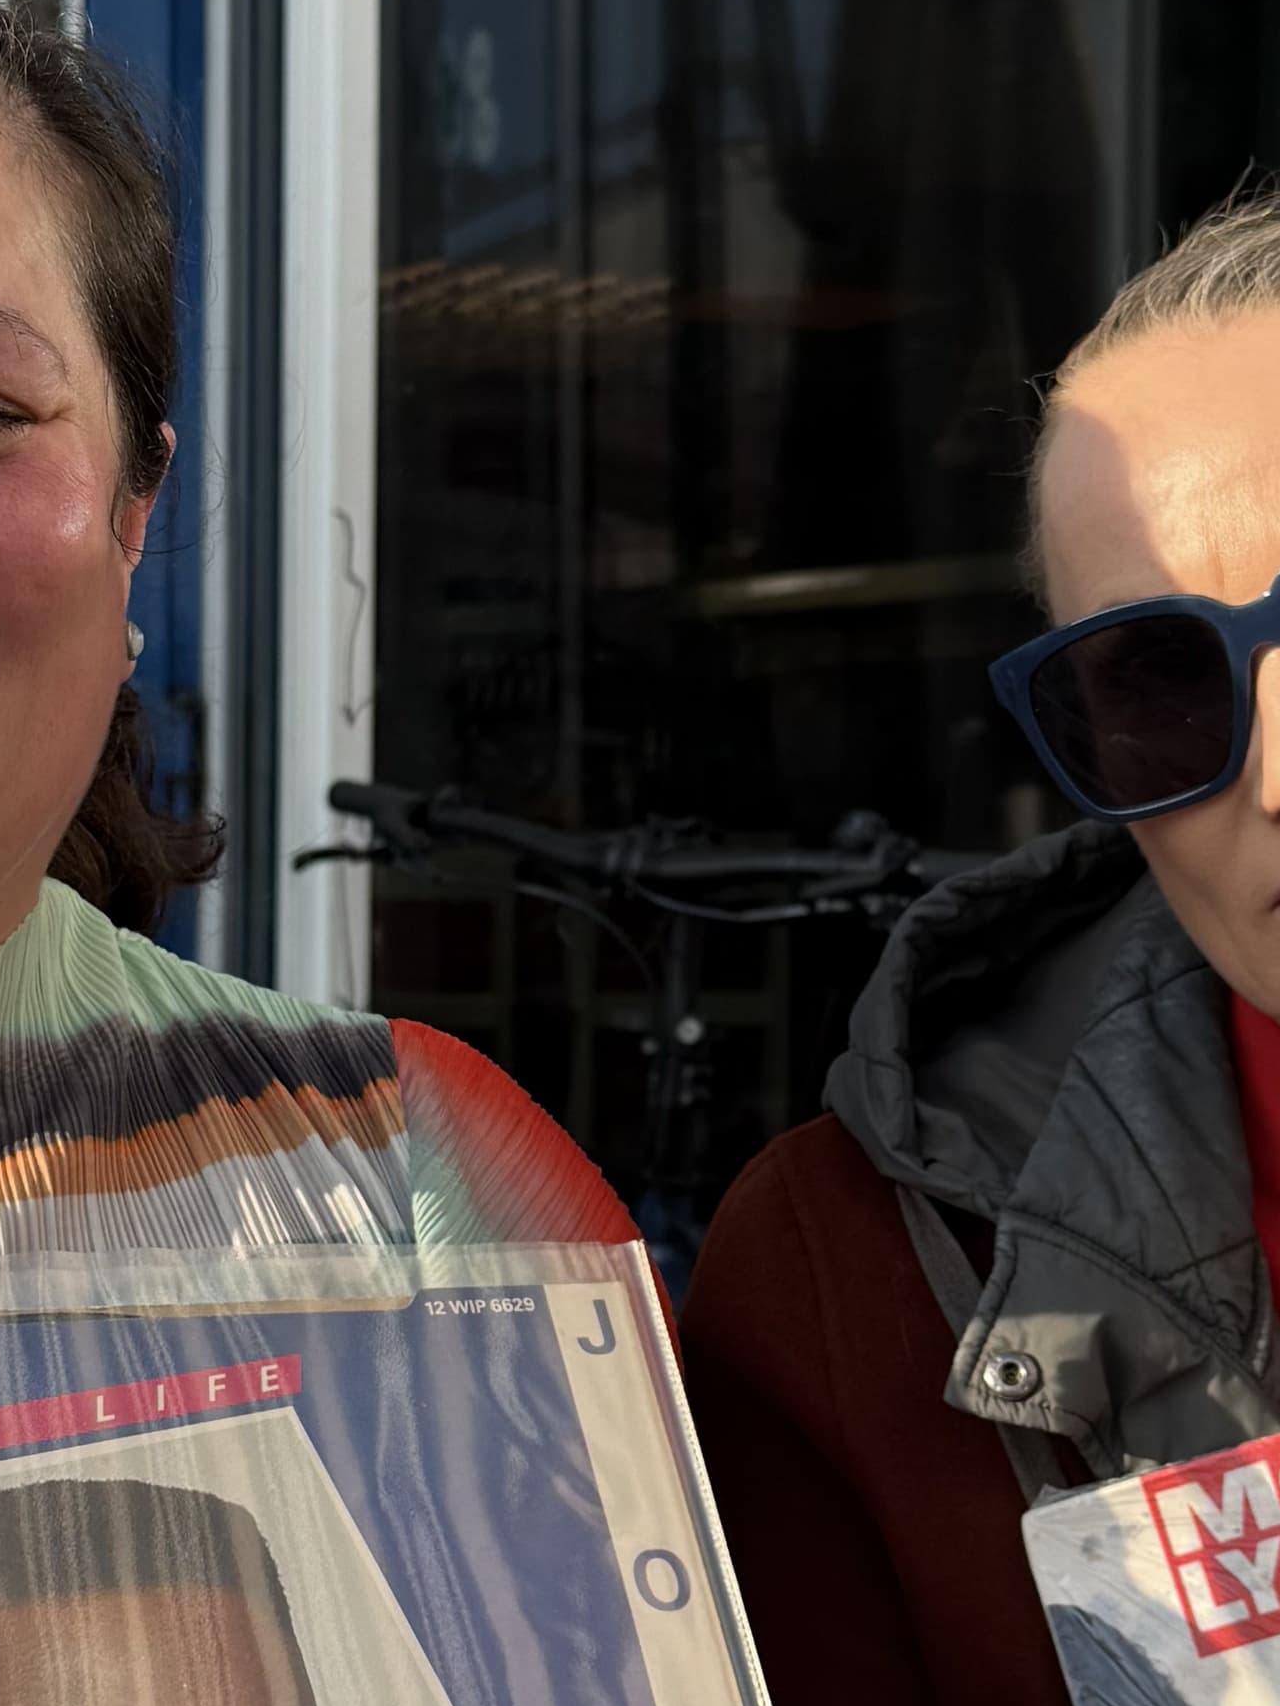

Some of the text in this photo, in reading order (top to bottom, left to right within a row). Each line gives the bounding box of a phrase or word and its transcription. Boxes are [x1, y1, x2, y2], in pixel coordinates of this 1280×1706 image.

[424, 1297, 536, 1316] 12 WIP 6629
[96, 1363, 280, 1424] LIFE
